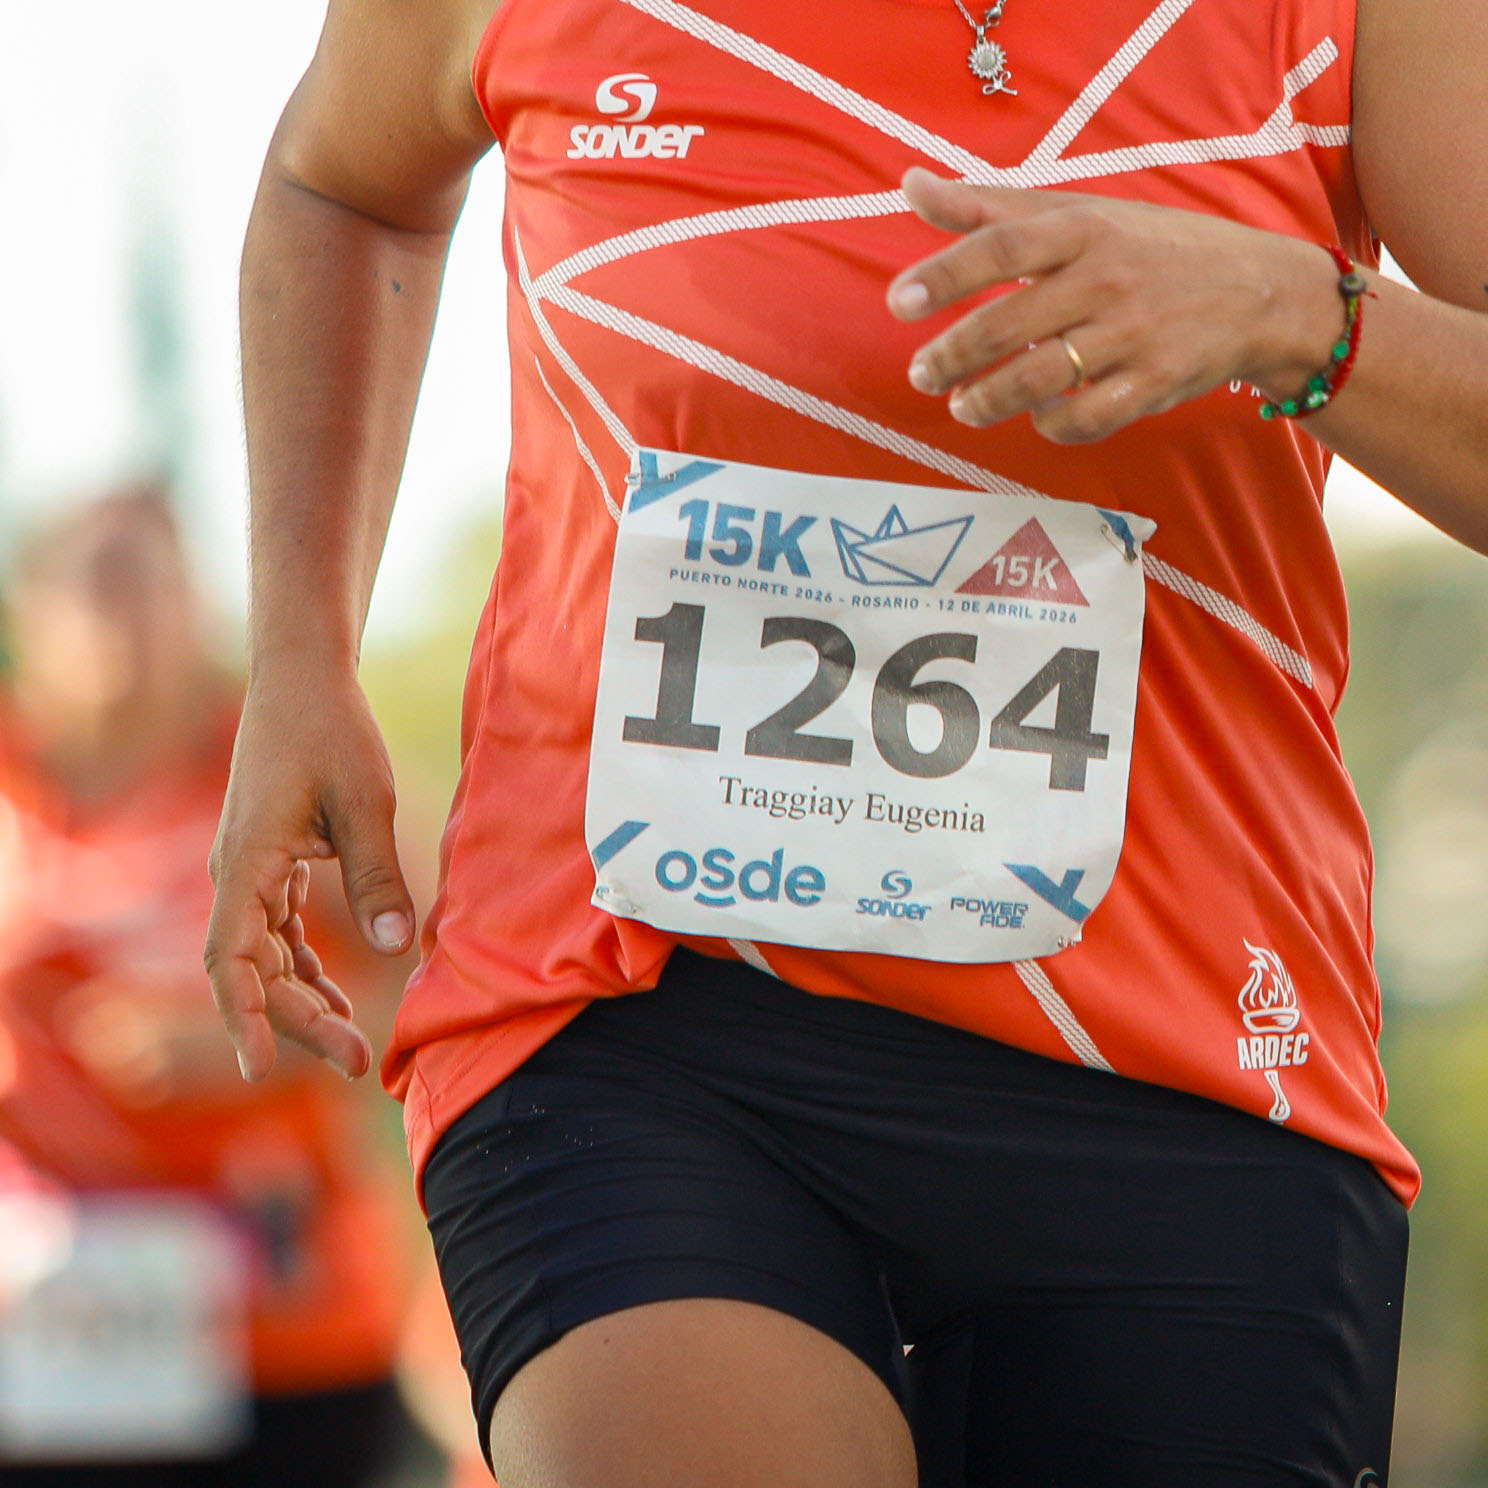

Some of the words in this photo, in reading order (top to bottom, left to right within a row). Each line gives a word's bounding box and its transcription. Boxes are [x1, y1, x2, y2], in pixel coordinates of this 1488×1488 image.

[678, 499, 818, 578] 15K
[670, 568, 731, 586] PUERTO
[738, 578, 788, 596] NORTE
[796, 588, 832, 603] 2026
[852, 596, 919, 609] ROSARIO
[939, 600, 954, 611] 12
[962, 601, 980, 613] DE
[986, 604, 1032, 620] ABRIL
[1040, 609, 1077, 624] 2026
[992, 556, 1060, 590] 15K
[622, 602, 1110, 793] 1264
[719, 776, 854, 825] Traggiay
[866, 792, 986, 834] Eugenia
[655, 847, 826, 908] osde
[950, 896, 1029, 916] POWER
[1237, 1033, 1310, 1070] ARDEC
